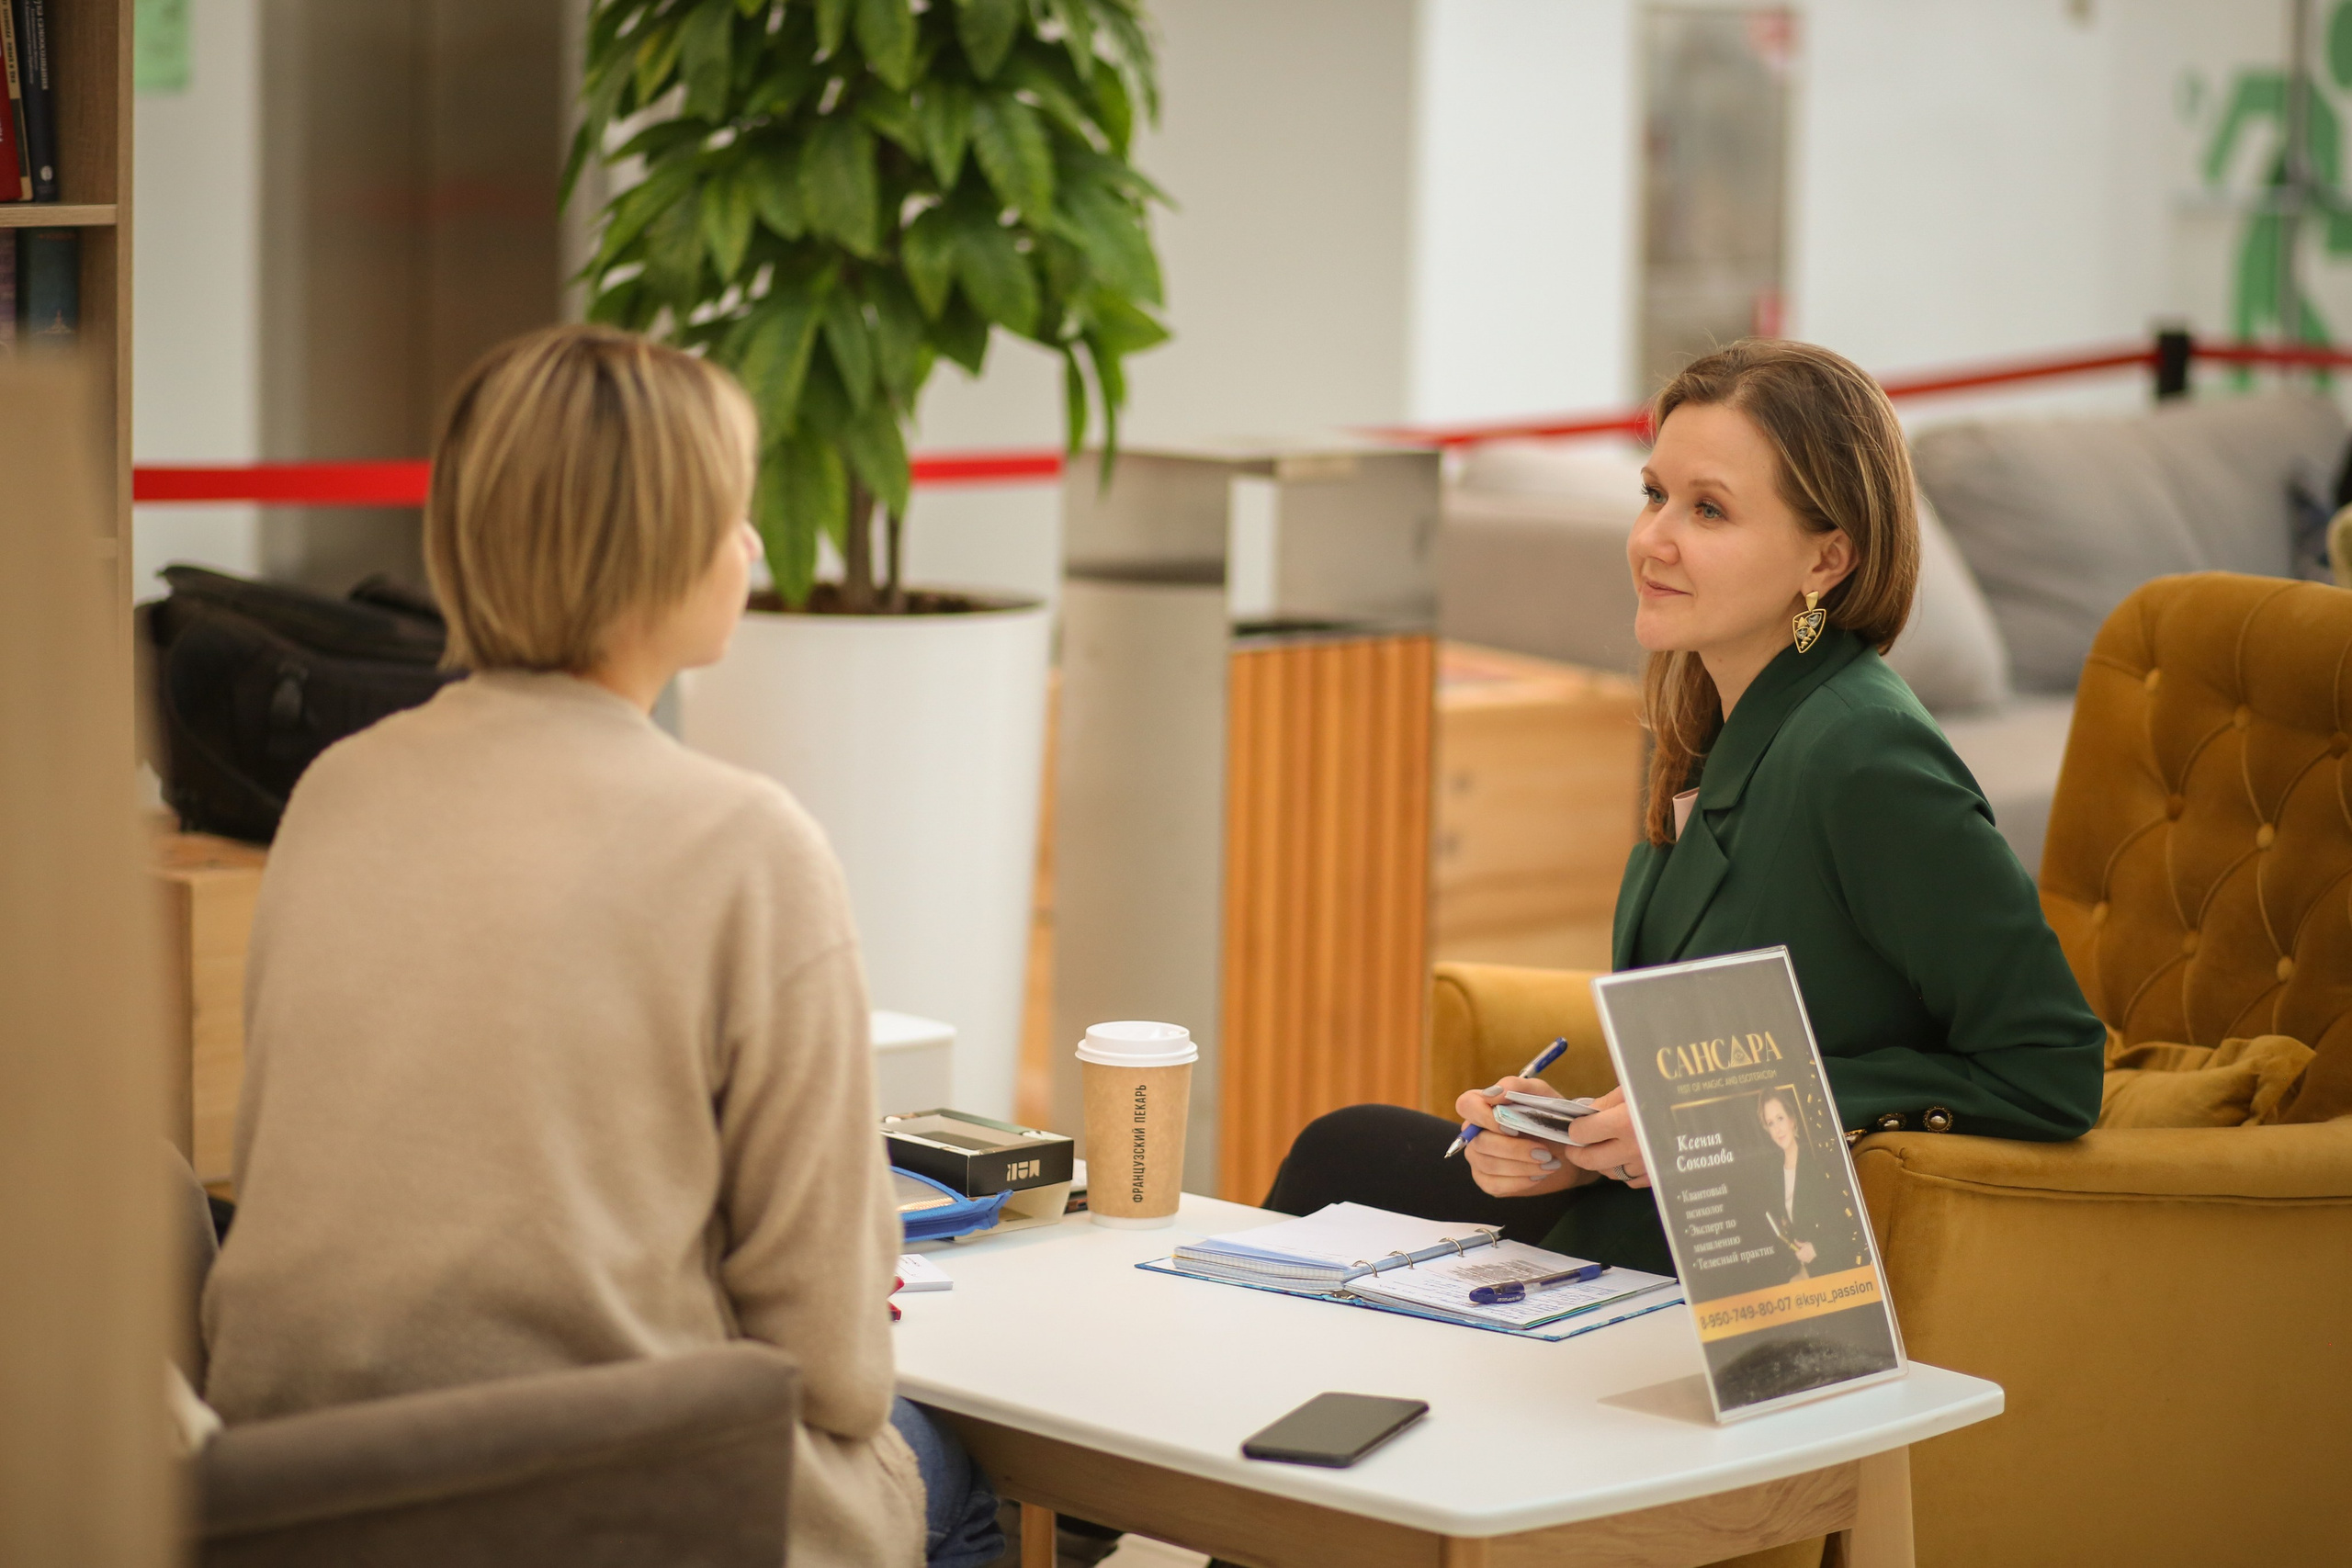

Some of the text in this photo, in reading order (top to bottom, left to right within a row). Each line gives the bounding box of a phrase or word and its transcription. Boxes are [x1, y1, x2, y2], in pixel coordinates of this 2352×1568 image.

[1657, 1031, 1783, 1080] САНСАРА
[1702, 1078, 1724, 1090] MAGIC
[1725, 1076, 1736, 1086] AND
[1738, 1069, 1778, 1083] ESOTERICISM
[1132, 1084, 1147, 1203] ФРАНЦУЗСКИЙ ПЕКАРЬ
[1677, 1133, 1723, 1152] Ксения
[1677, 1148, 1735, 1172] Соколова
[1681, 1183, 1728, 1202] Квантовый
[1686, 1204, 1724, 1220] психолог
[1688, 1219, 1736, 1236] Эксперт по
[1693, 1235, 1741, 1253] мышлению
[1698, 1245, 1775, 1270] Телесный практик
[1700, 1280, 1874, 1330] 8-950-749-80-07 @ksyu_passion
